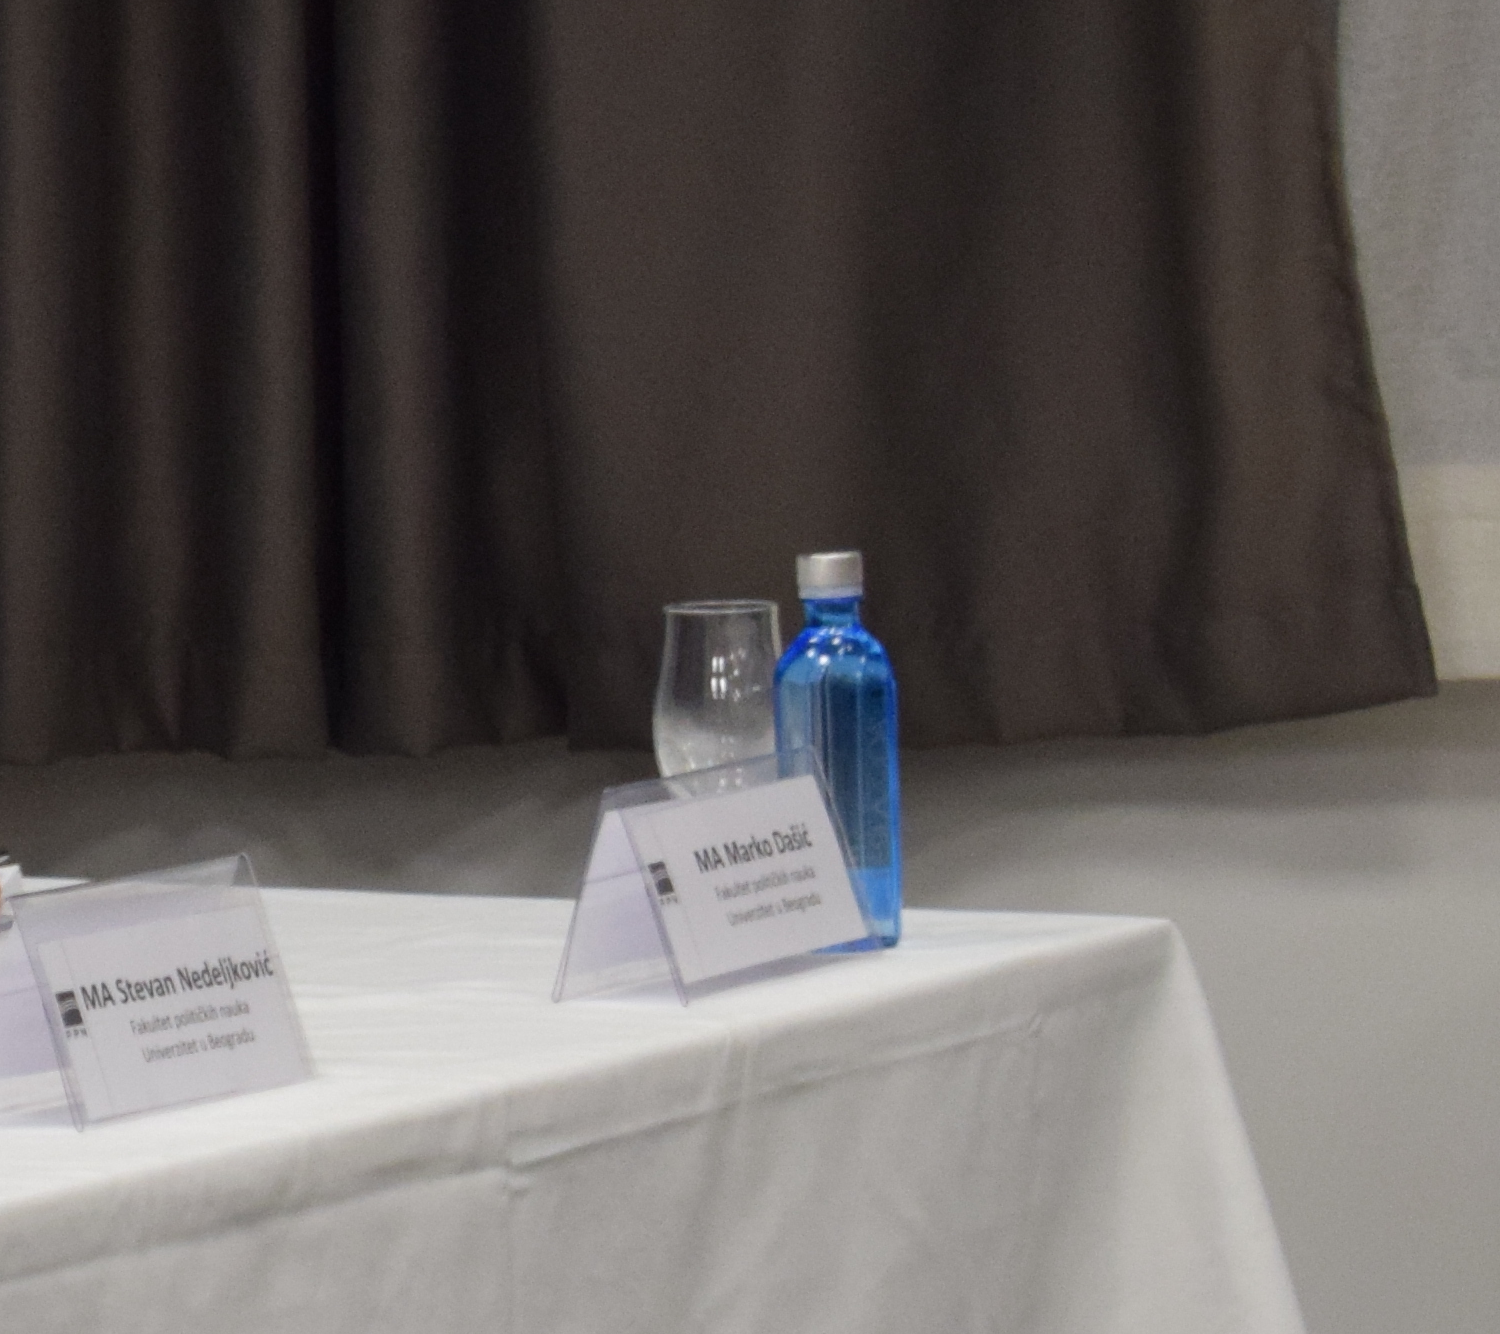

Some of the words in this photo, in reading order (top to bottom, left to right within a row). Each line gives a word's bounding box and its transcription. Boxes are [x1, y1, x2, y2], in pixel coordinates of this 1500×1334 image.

[693, 846, 725, 873] MA
[723, 835, 773, 865] Marko
[80, 982, 116, 1010] MA
[115, 975, 177, 1004] Stevan
[175, 949, 274, 991] Nedeljković
